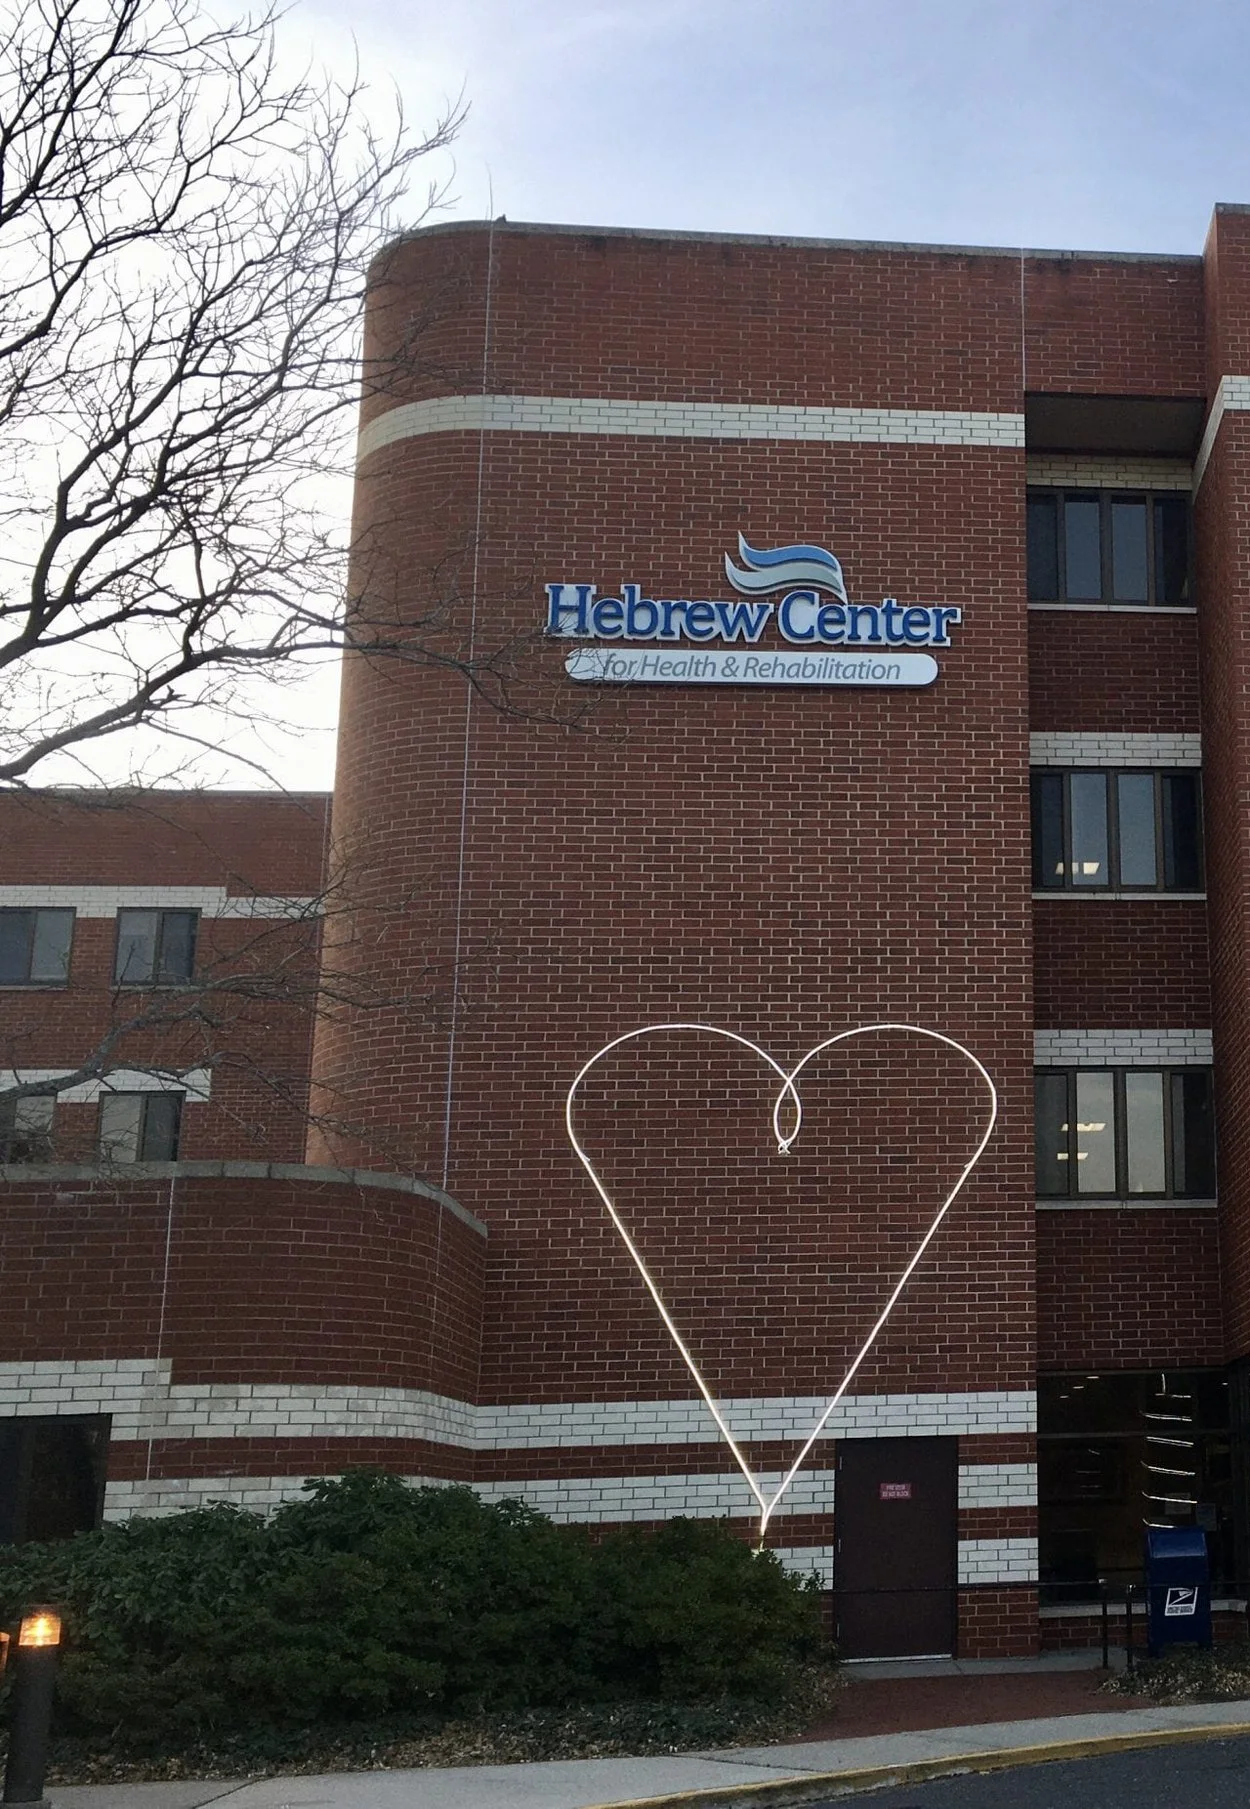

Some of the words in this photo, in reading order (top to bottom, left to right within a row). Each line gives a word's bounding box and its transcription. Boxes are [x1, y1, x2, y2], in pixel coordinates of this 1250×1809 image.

[546, 584, 773, 639] Hebrew
[781, 591, 958, 643] Center
[602, 653, 638, 680] for
[640, 654, 717, 679] Health
[720, 656, 740, 679] &
[743, 655, 901, 680] Rehabilitation
